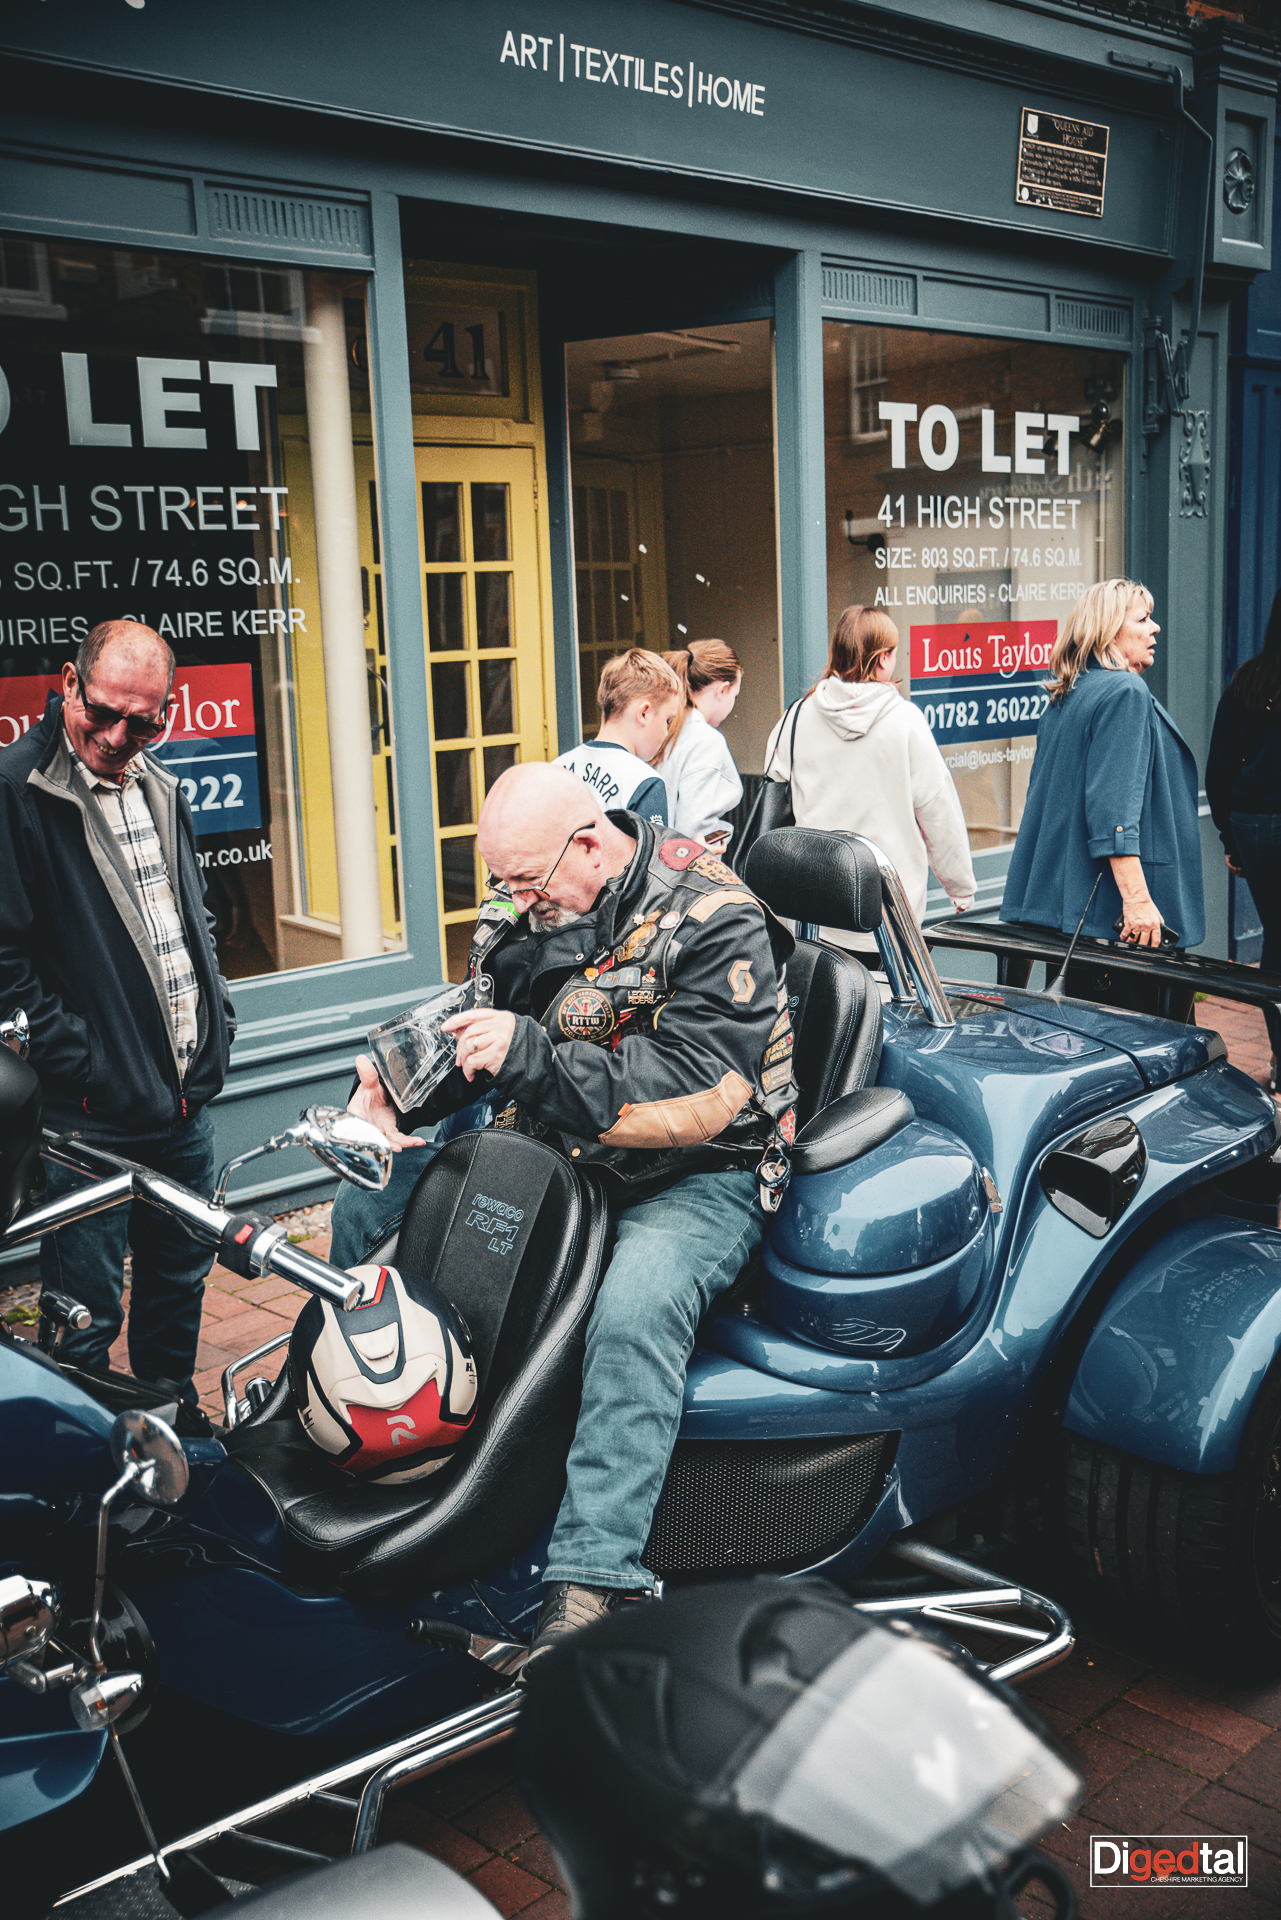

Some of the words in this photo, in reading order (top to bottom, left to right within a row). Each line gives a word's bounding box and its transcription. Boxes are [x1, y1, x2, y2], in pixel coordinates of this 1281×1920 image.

[500, 30, 553, 71] ART
[570, 43, 684, 98] TEXTILES
[698, 71, 766, 116] HOME
[1082, 125, 1094, 137] AID
[423, 322, 490, 380] 41
[61, 352, 278, 451] LET
[878, 401, 960, 472] TO
[982, 408, 1080, 476] LET
[90, 485, 289, 531] STREET
[877, 494, 906, 529] 41
[917, 495, 981, 529] HIGH
[988, 496, 1081, 530] STREET
[14, 560, 119, 591] SQ.FT.
[147, 559, 209, 588] 74.6
[218, 556, 301, 587] SQ.M.
[875, 547, 916, 569] SIZE:
[921, 547, 949, 569] 803
[952, 547, 1000, 569] SQ.FT.
[1013, 547, 1041, 568] 74.6
[1044, 547, 1083, 567] SQ.M.
[874, 586, 902, 607] ALL
[906, 584, 986, 607] ENQUIRIES
[998, 583, 1046, 603] CLAIRE
[0, 616, 89, 646] IRIES
[121, 611, 224, 639] AIRE
[231, 607, 308, 636] KERR
[922, 633, 982, 672] Louis
[987, 631, 1052, 678] Taylor
[924, 700, 979, 730] 01782
[582, 762, 619, 803] SARR
[625, 970, 634, 984] H
[572, 1015, 600, 1026] RTTW
[472, 1193, 524, 1221] rewaco
[465, 1210, 519, 1242] RF1
[488, 1238, 513, 1255] LT
